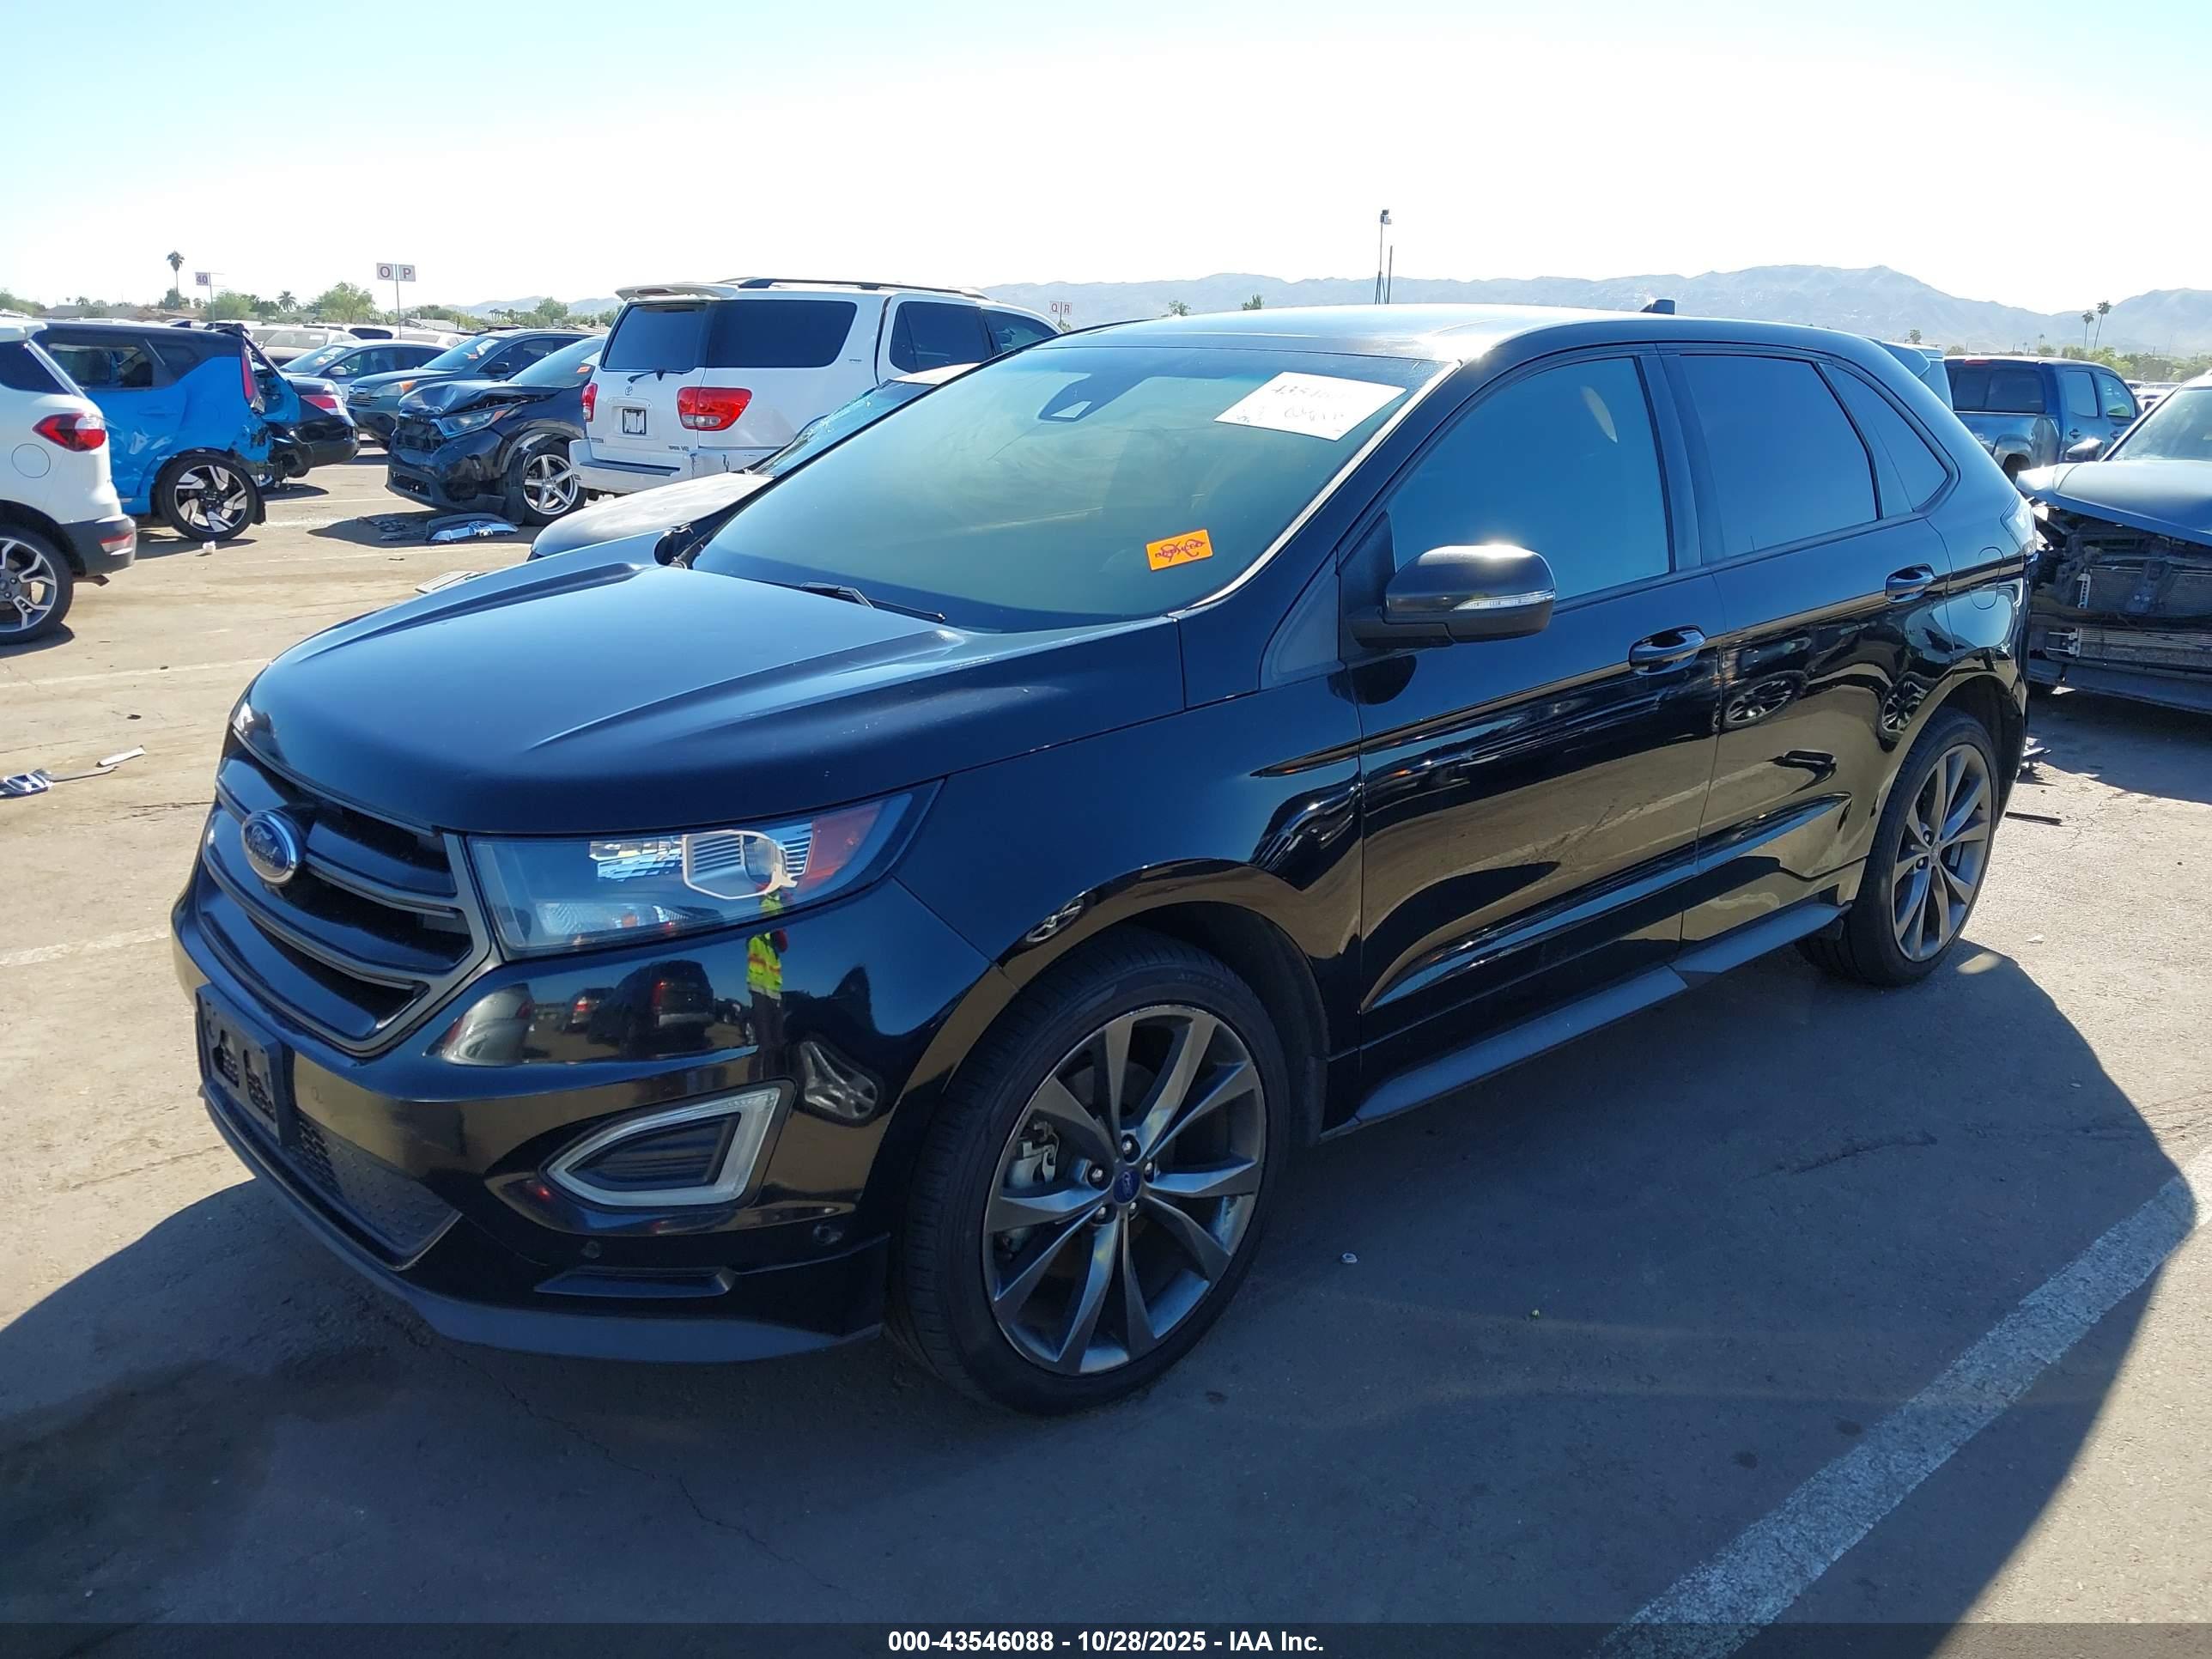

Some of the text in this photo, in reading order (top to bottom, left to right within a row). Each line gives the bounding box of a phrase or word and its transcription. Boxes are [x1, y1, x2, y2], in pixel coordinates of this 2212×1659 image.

[380, 265, 411, 279] O P
[197, 274, 208, 283] 40
[1051, 303, 1070, 313] Q R
